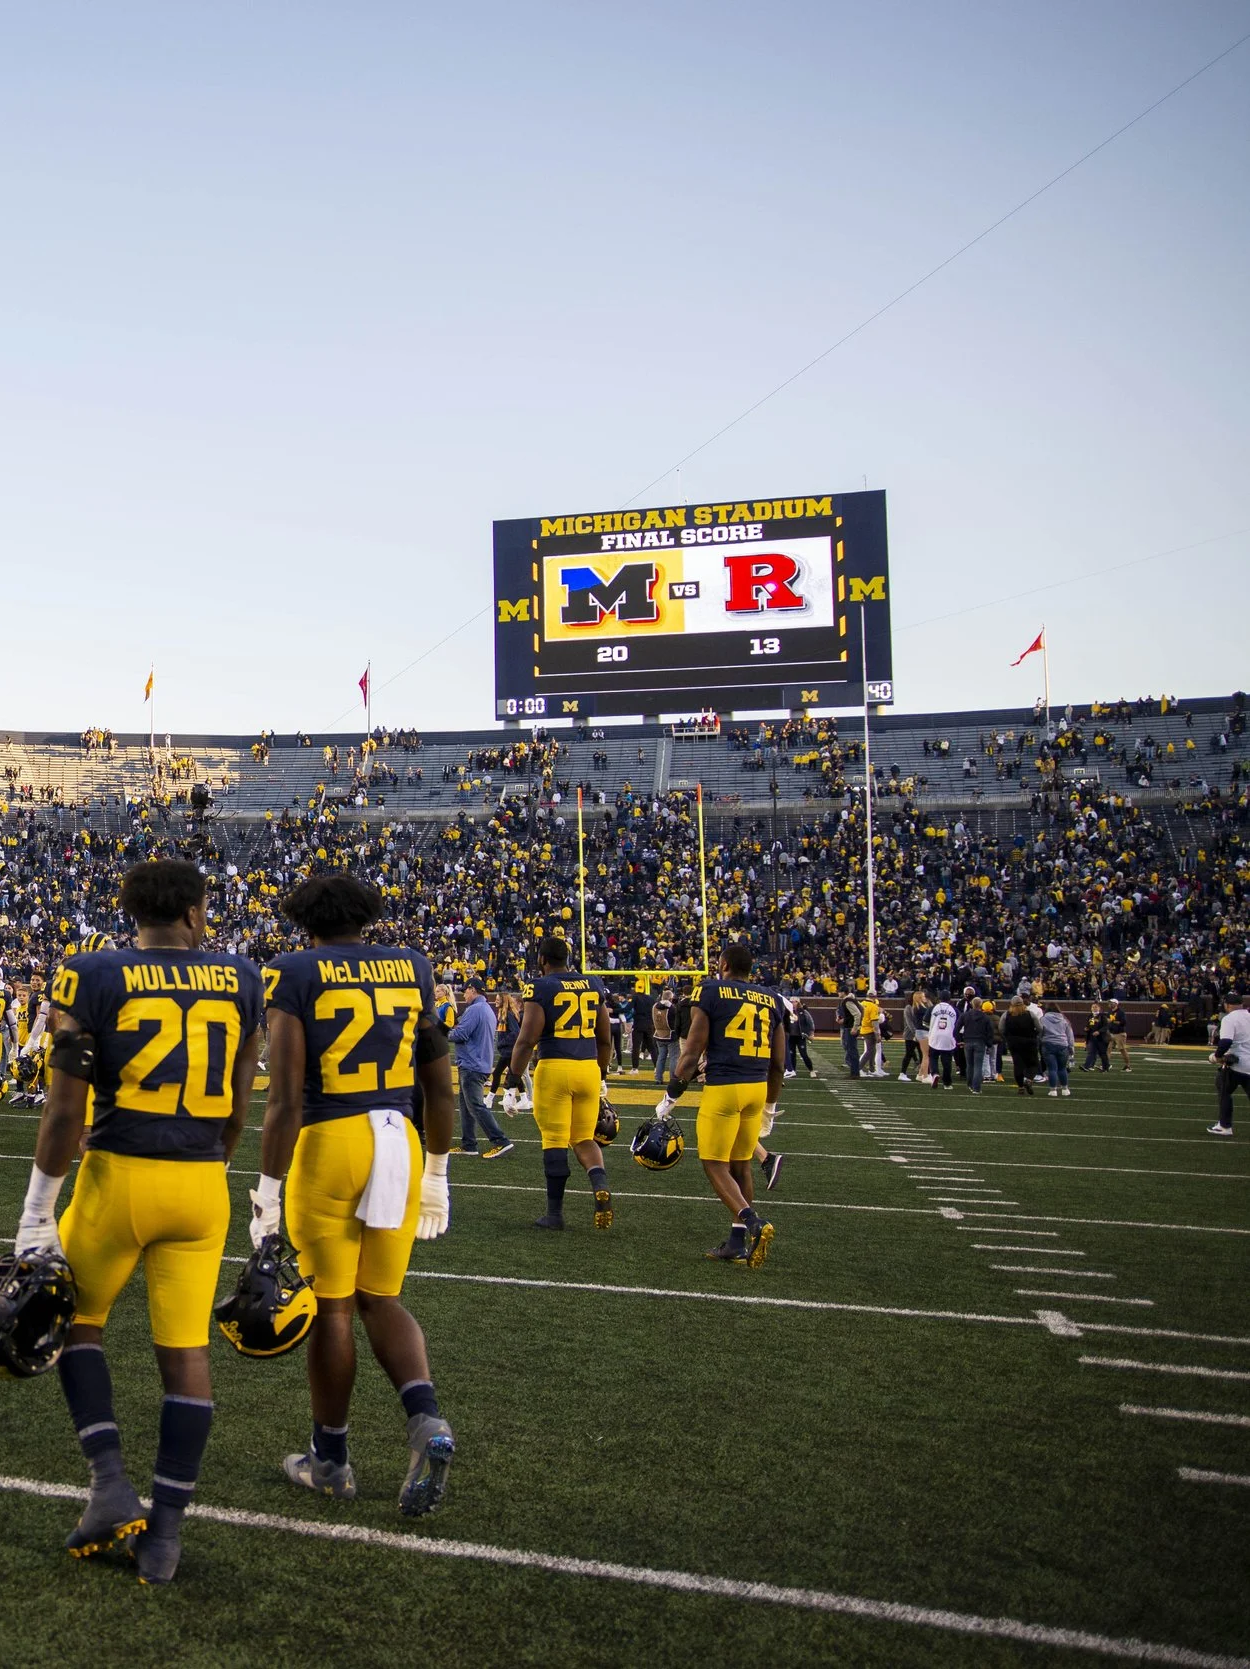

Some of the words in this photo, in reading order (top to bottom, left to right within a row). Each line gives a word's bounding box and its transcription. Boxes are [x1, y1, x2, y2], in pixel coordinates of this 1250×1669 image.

[540, 508, 687, 537] MICHIGAN
[693, 497, 833, 525] STADIUM
[600, 530, 675, 550] FINAL
[680, 524, 763, 545] SCORE
[724, 553, 805, 613] R
[849, 576, 886, 602] M
[498, 599, 531, 623] M
[597, 645, 628, 663] 20
[750, 637, 781, 655] 13
[868, 682, 892, 700] 40
[506, 697, 545, 715] 0:00
[122, 964, 240, 994] MULLINGS
[317, 959, 416, 984] McLAURIN
[561, 979, 590, 990] BENNY
[51, 964, 79, 1007] 20
[718, 986, 777, 1009] HILL-GREEN
[553, 991, 600, 1039] 26
[315, 988, 424, 1095] 27
[724, 1002, 771, 1059] 41
[115, 997, 242, 1118] 20
